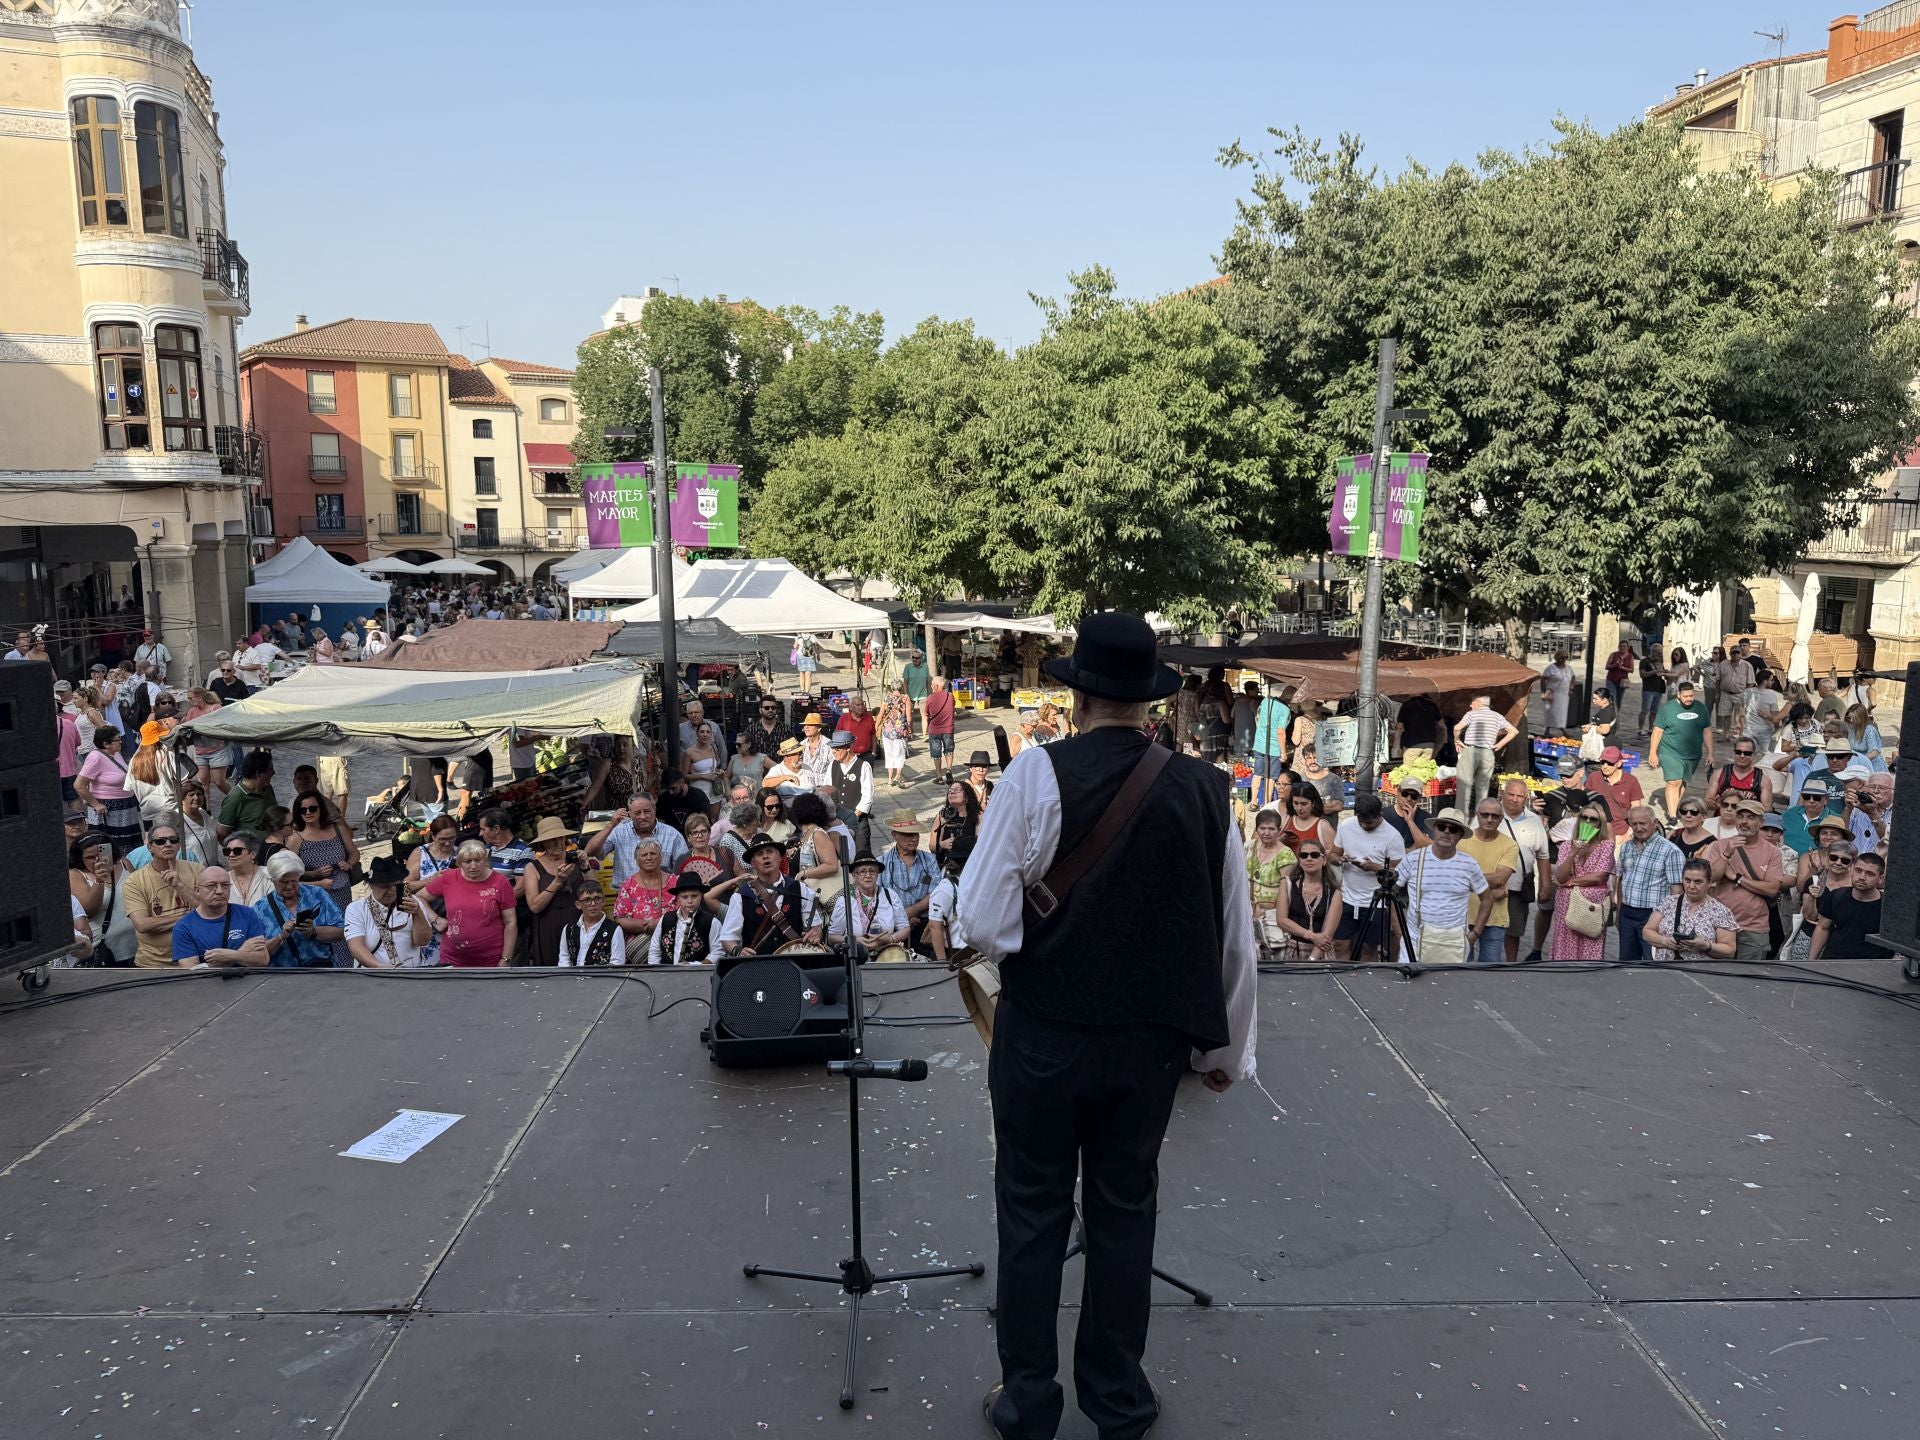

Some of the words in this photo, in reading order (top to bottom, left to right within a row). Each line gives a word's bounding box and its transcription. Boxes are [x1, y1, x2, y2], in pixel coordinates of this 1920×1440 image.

[589, 489, 643, 505] MARTES
[1390, 486, 1423, 505] MARTES
[597, 506, 639, 520] MAYOR
[1392, 508, 1415, 528] MAYOR
